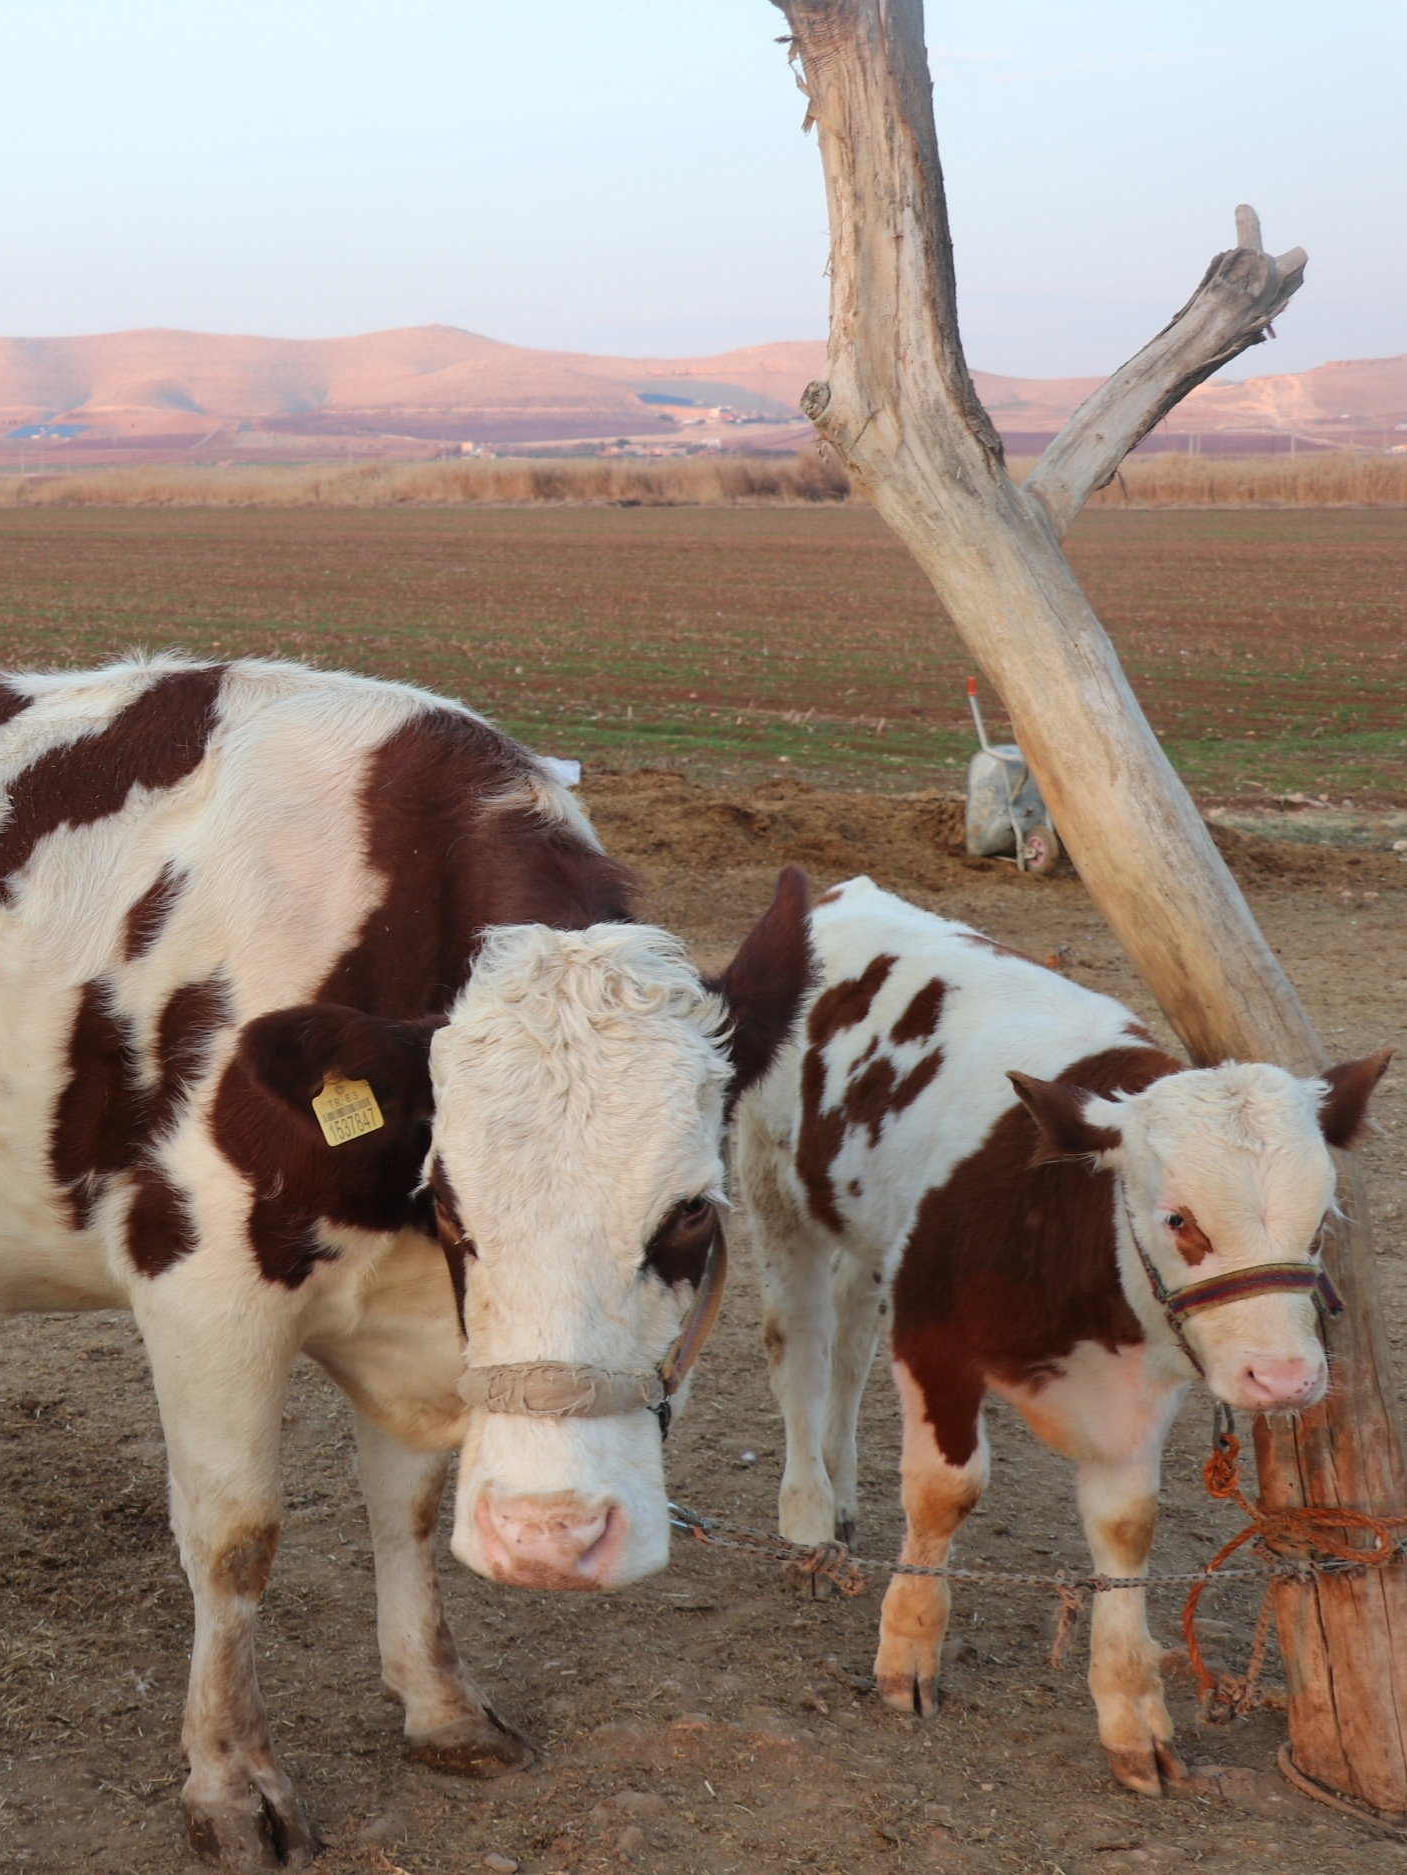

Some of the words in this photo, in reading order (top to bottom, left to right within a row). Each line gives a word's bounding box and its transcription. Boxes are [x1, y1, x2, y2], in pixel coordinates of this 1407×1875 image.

[327, 1098, 342, 1110] TR
[345, 1091, 359, 1103] 63
[329, 1107, 377, 1142] 1537847
